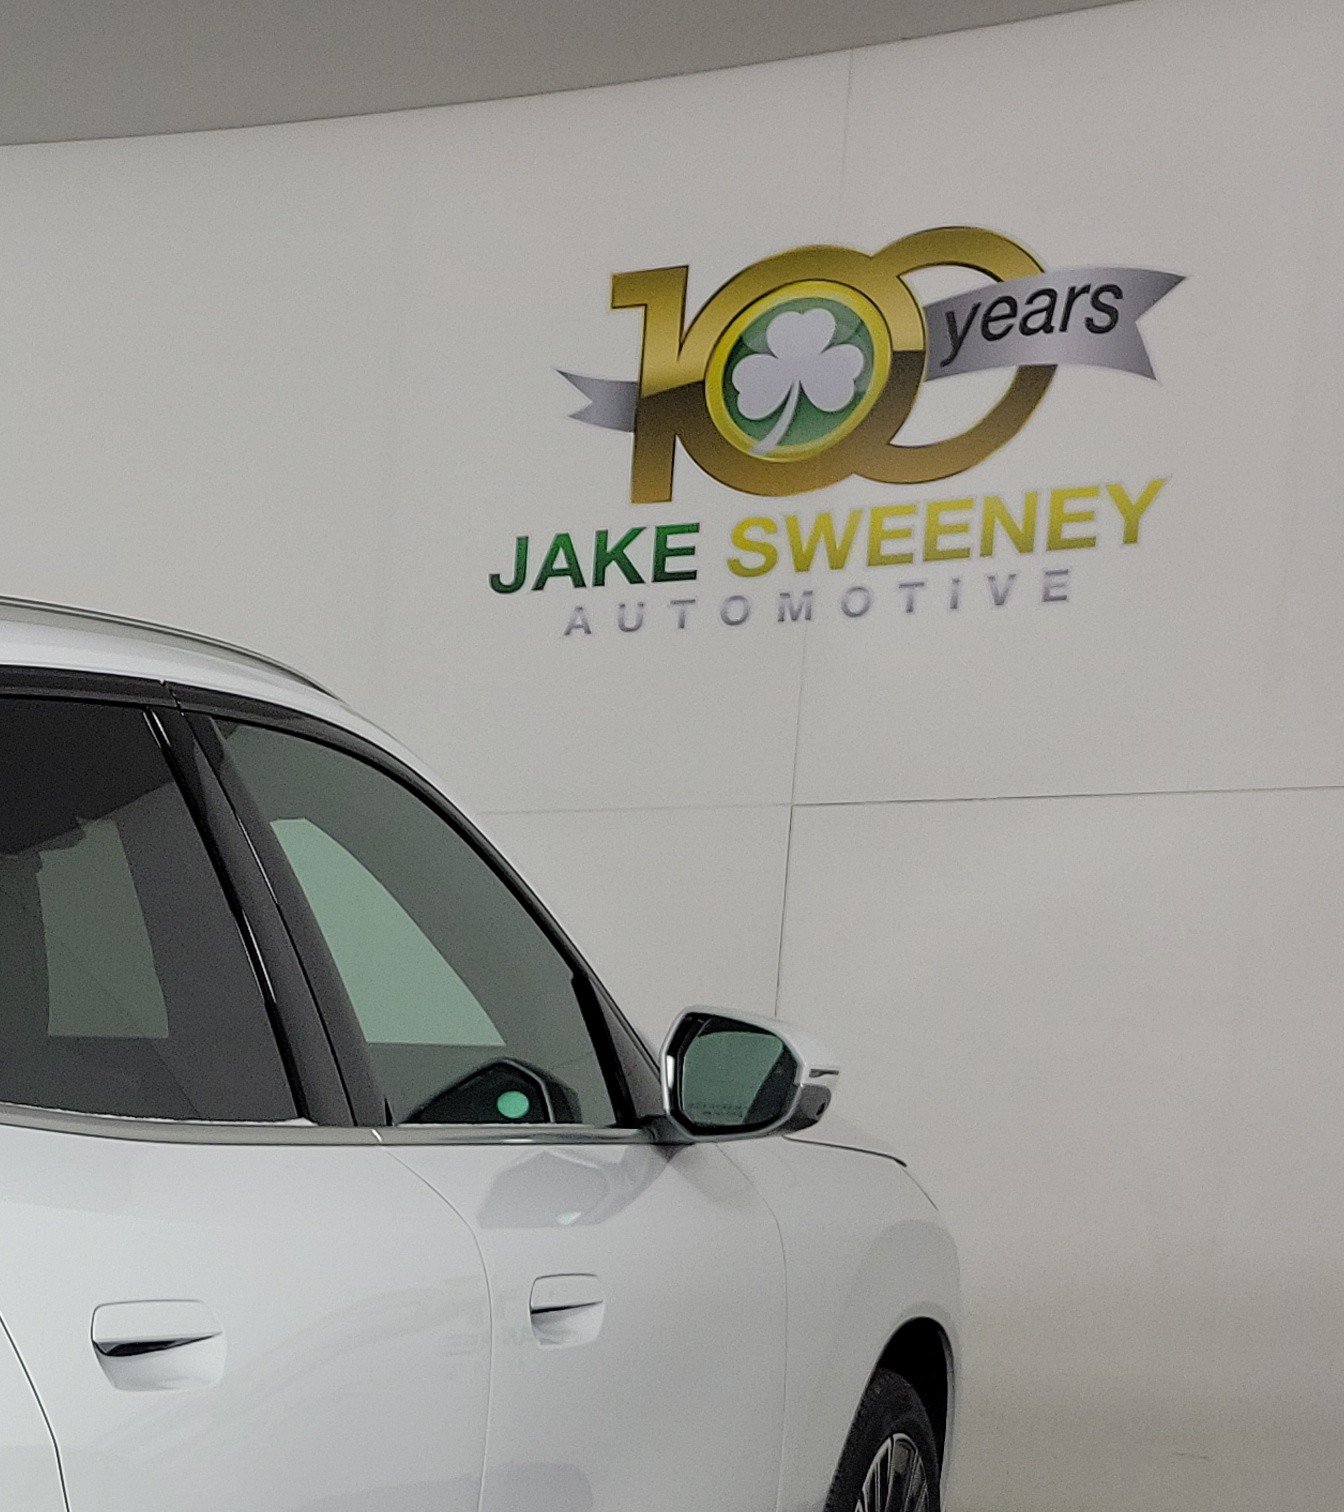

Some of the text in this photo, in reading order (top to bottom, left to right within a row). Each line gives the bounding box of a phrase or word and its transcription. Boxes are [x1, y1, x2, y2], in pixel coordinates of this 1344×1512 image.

[611, 226, 1125, 504] 100 years
[489, 477, 1166, 595] JAKE SWEENEY
[563, 569, 1073, 636] AUTOMOTIVE
